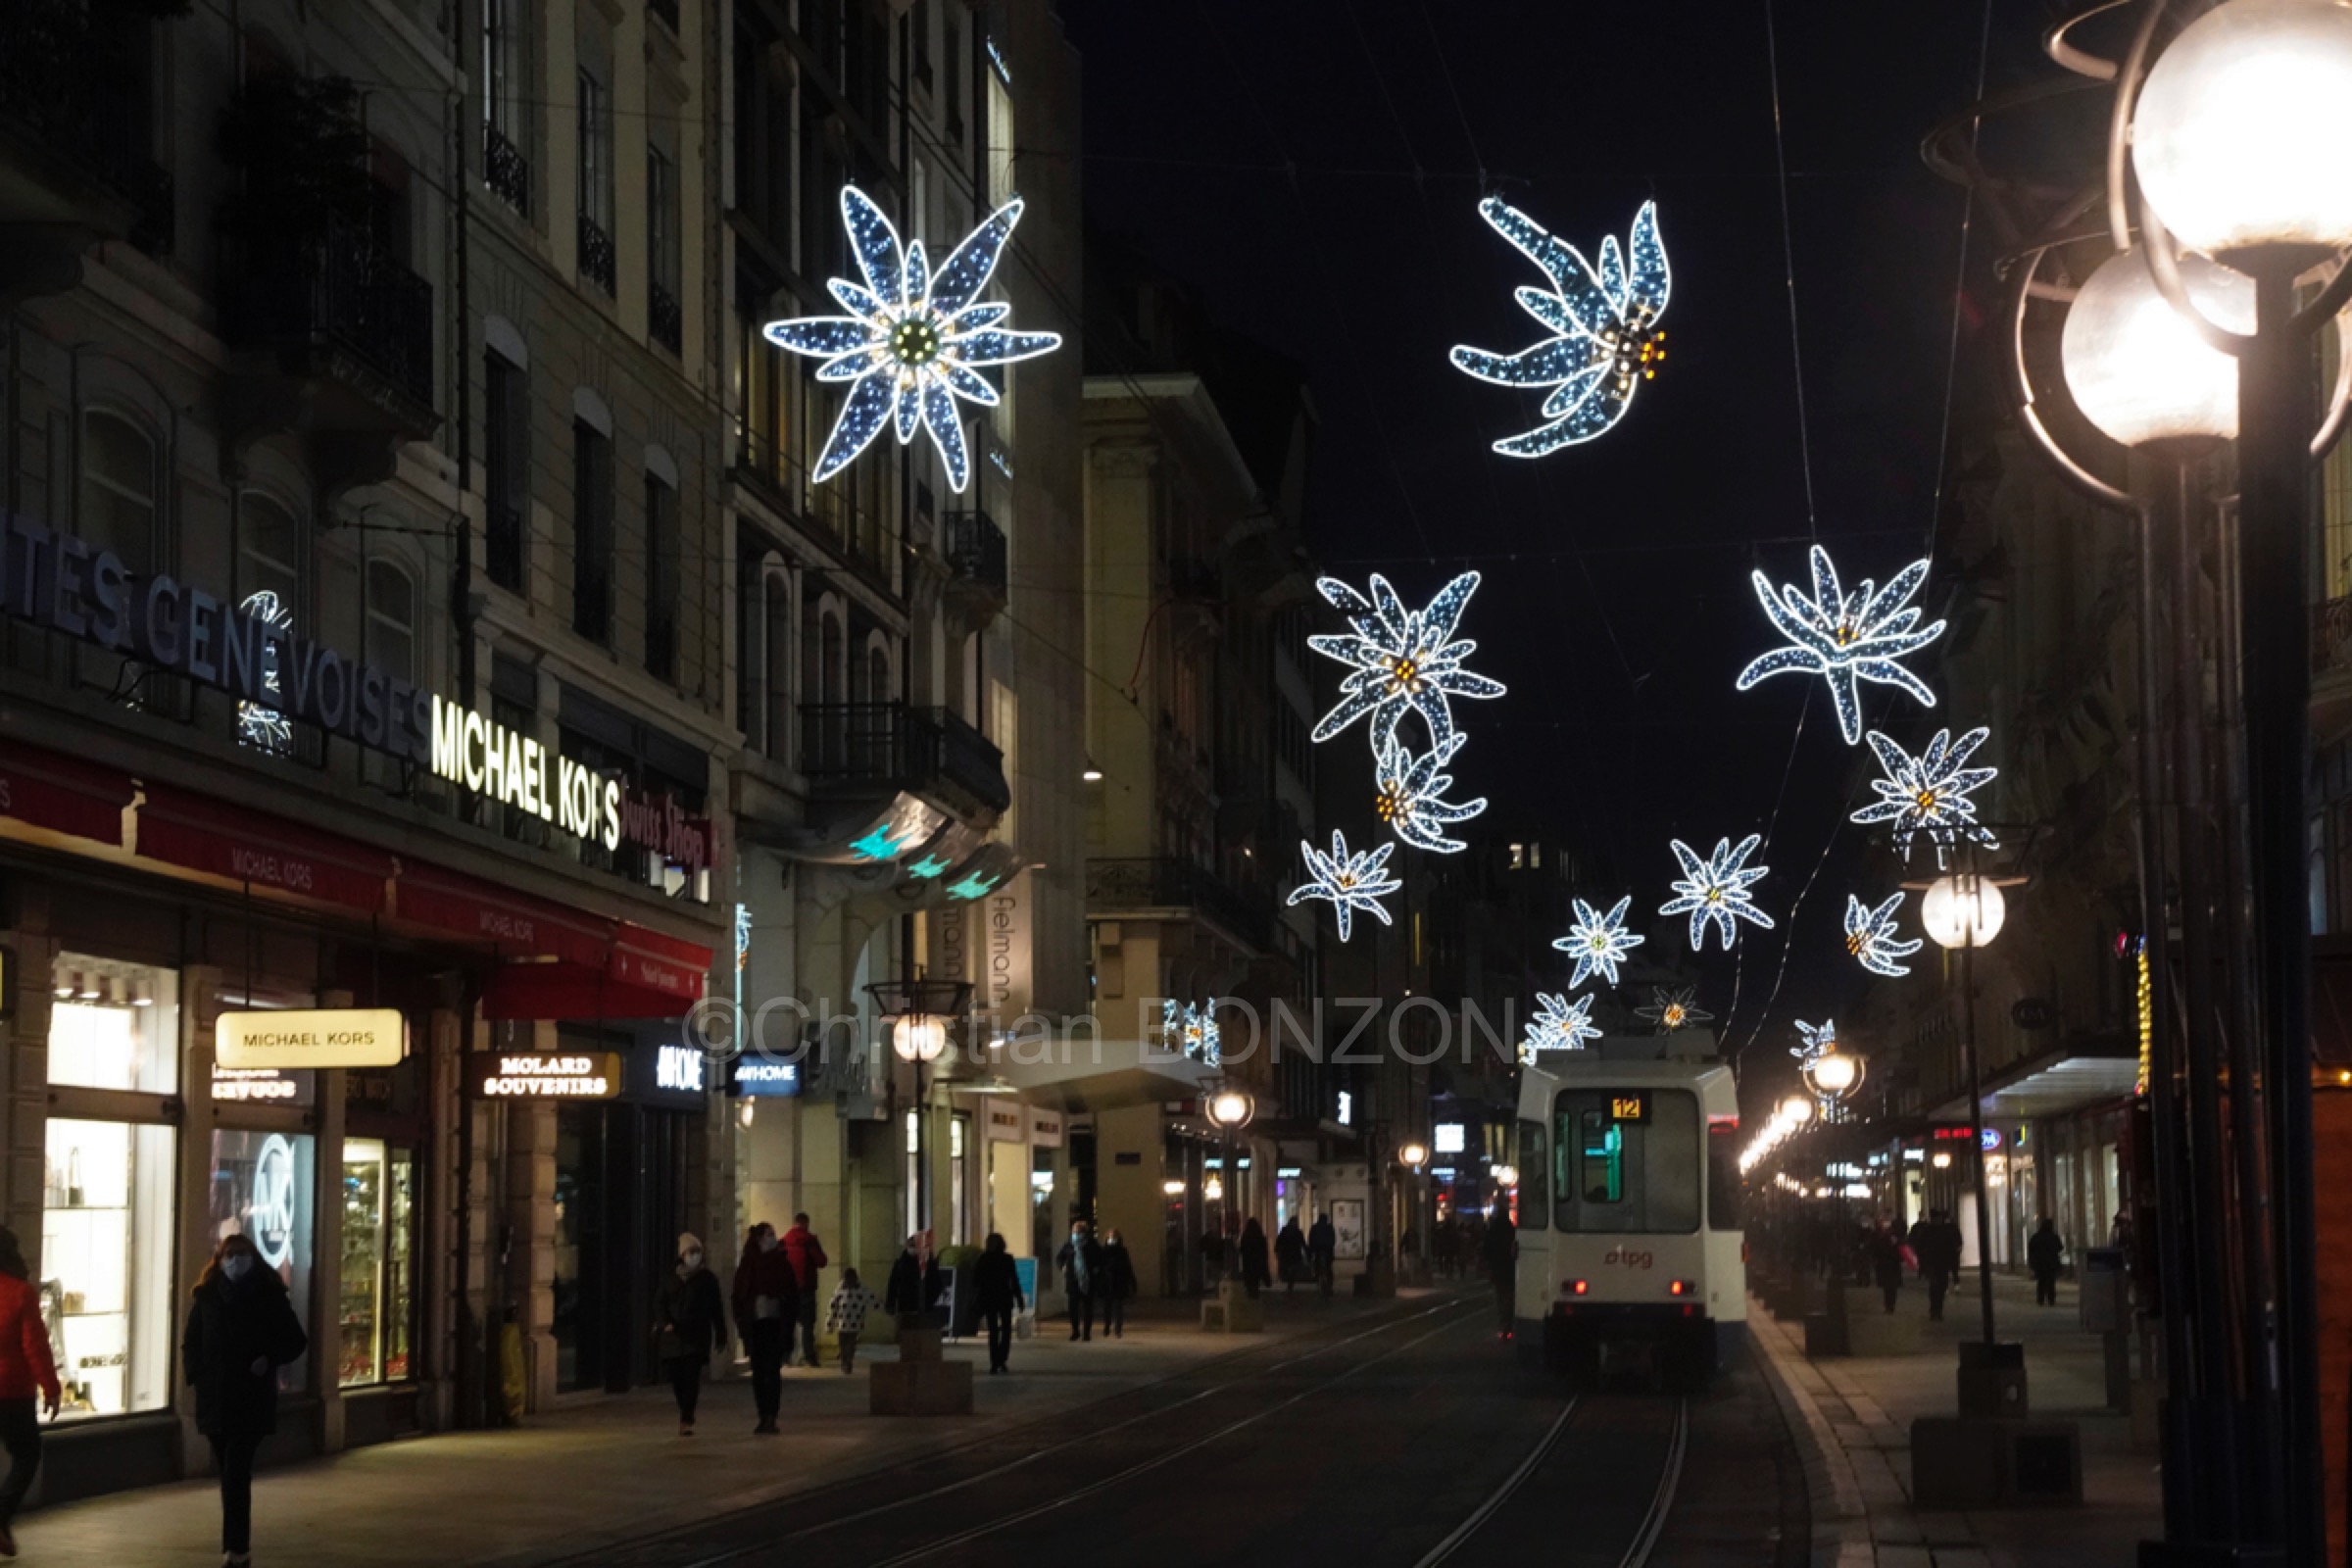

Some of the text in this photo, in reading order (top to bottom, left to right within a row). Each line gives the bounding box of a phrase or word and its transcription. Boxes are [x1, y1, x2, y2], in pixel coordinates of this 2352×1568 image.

[0, 506, 431, 764] TES GENEVOISES
[431, 694, 619, 851] MICHAEL KORS
[232, 847, 313, 890] MICHAEL KORS
[243, 1031, 375, 1048] MICHAEL KORS
[500, 1056, 593, 1075] MOLARD
[483, 1077, 609, 1096] SOUVENIRS
[1612, 1099, 1641, 1118] 12
